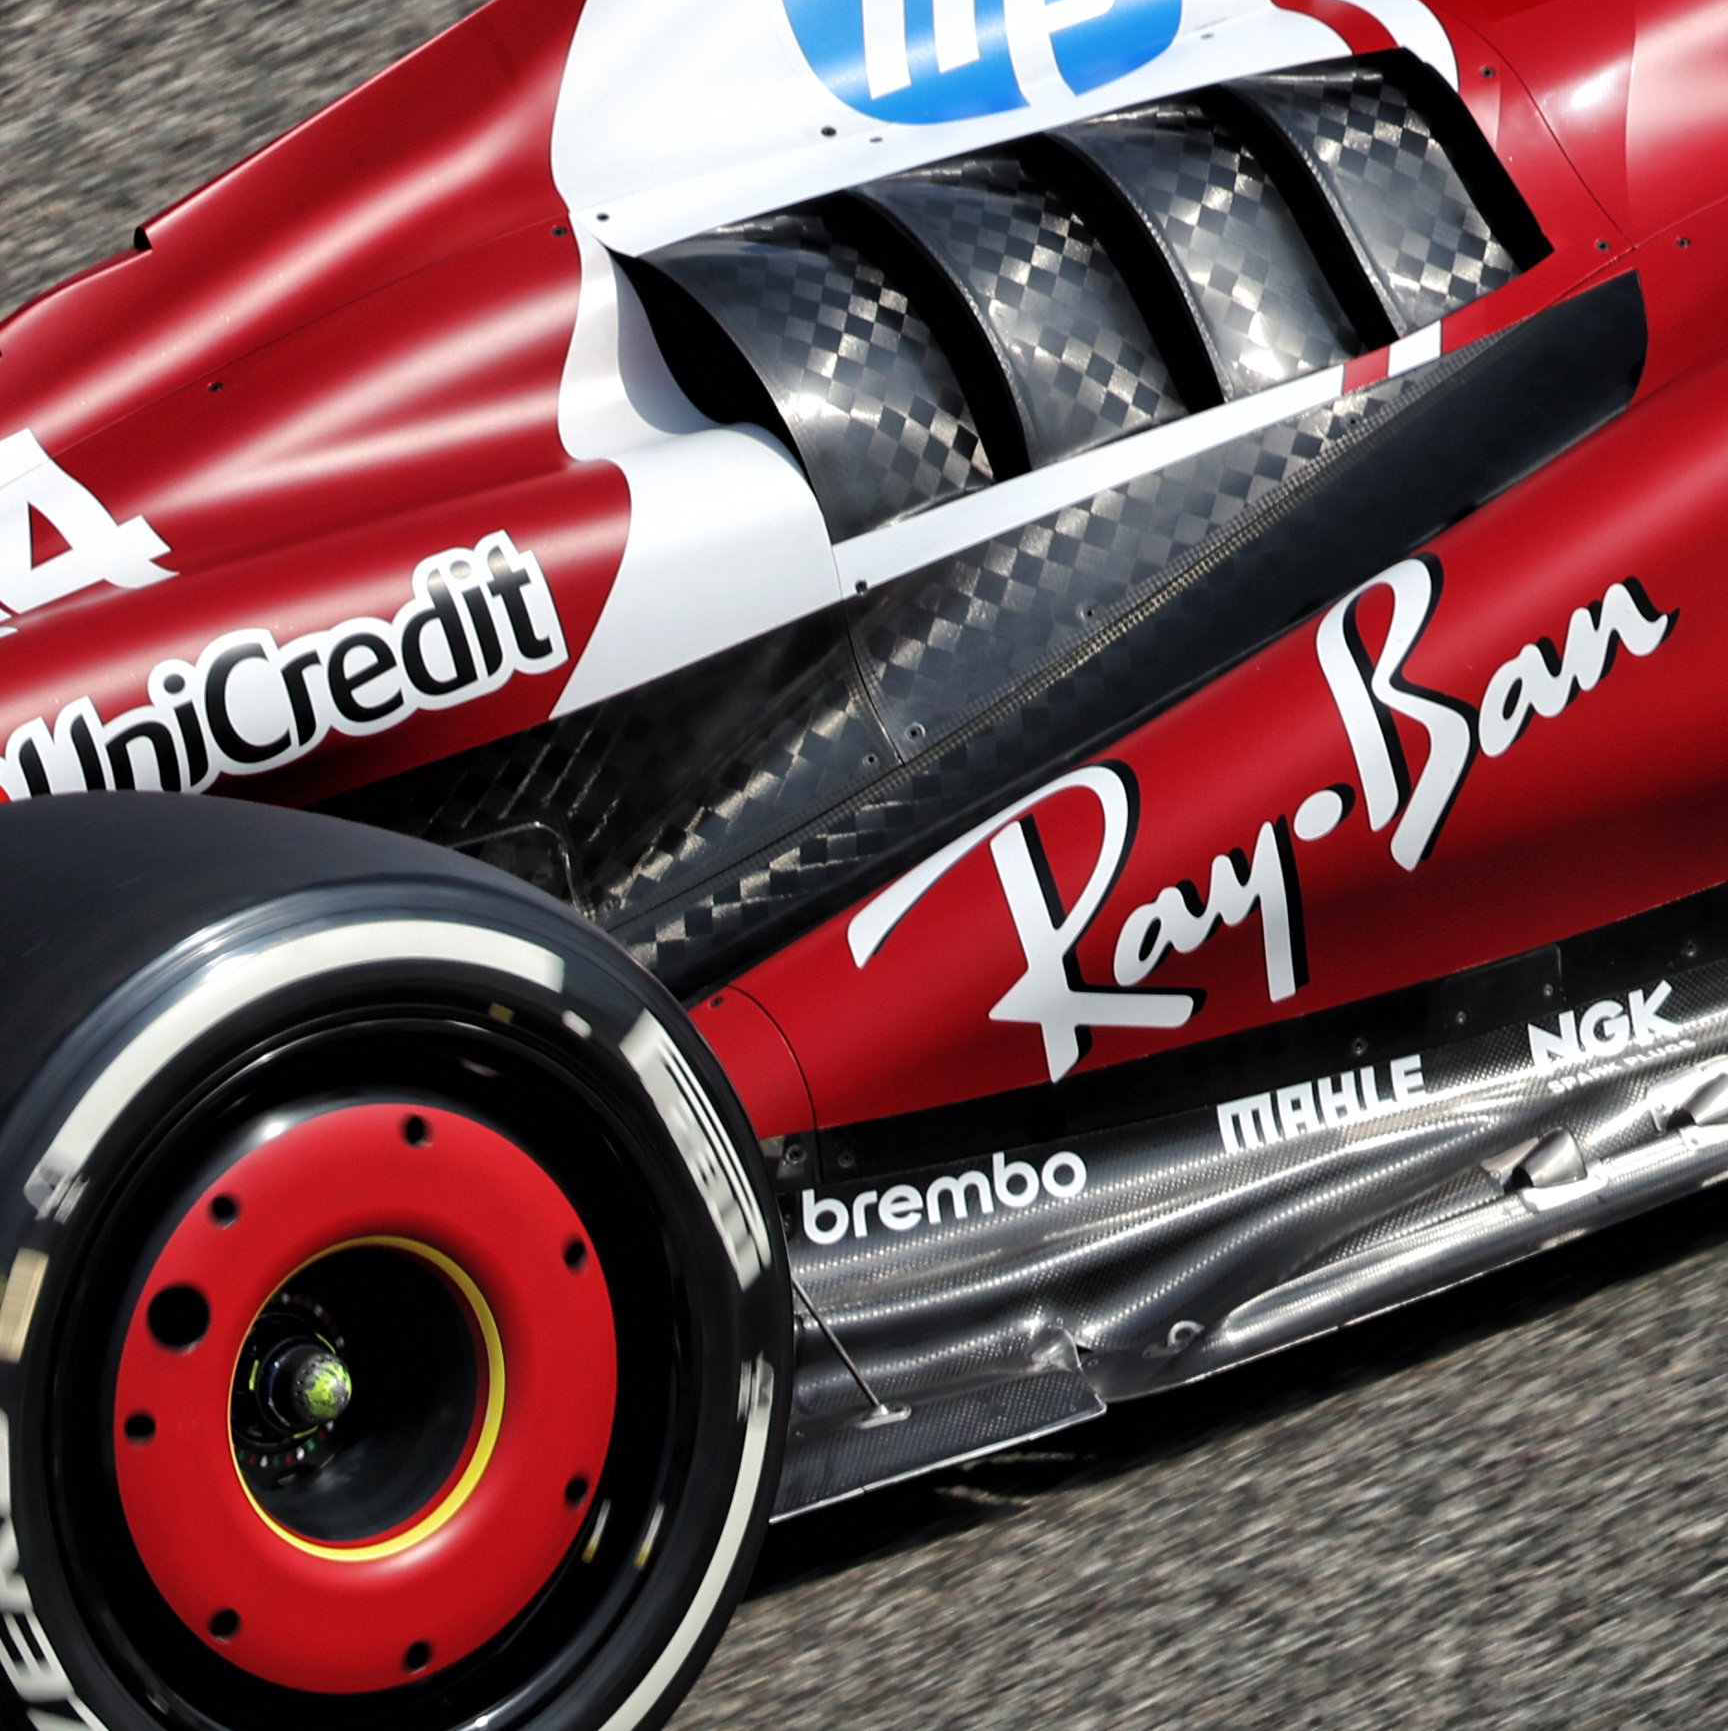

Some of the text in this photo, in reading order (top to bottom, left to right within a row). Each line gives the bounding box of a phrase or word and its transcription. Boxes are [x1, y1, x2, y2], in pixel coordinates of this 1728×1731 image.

[18, 544, 554, 795] UniCredit
[1527, 979, 1680, 1074] NGK
[1547, 1039, 1697, 1094] SPARK PLUGS
[1217, 1054, 1427, 1156] MAHLE
[801, 1150, 1088, 1246] brembo
